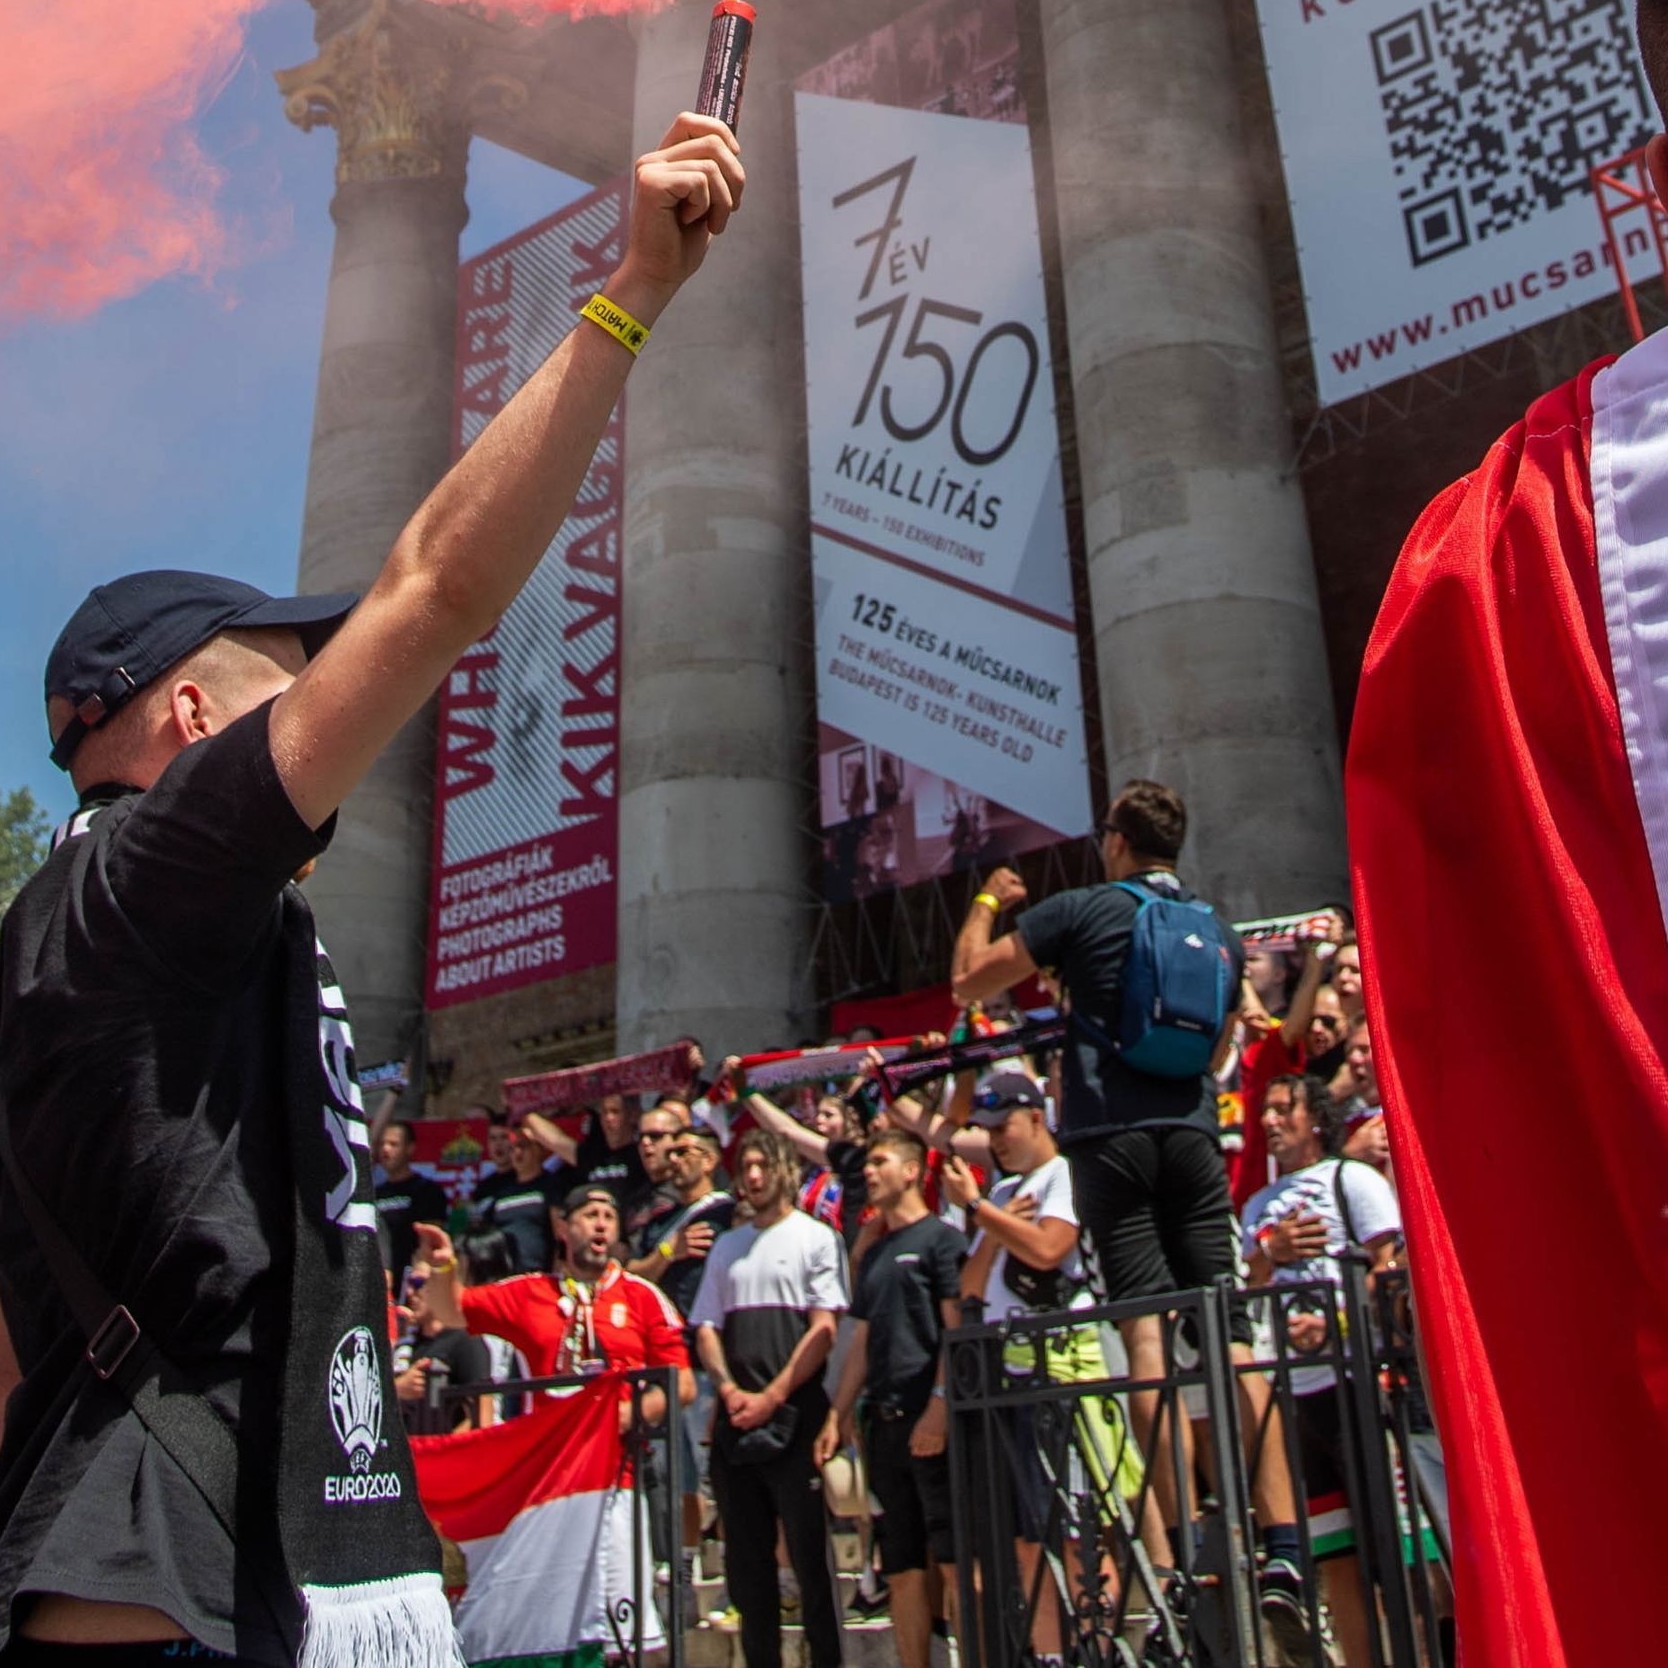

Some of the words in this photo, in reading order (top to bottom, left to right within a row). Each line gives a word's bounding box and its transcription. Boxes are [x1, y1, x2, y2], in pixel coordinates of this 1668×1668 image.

[832, 154, 919, 302] 7
[888, 235, 932, 286] ÉV
[461, 258, 512, 420] ARE
[852, 291, 1039, 467] 150
[835, 496, 871, 526] YEARS
[882, 514, 905, 538] 150
[903, 522, 986, 568] EXHIBITIONS
[836, 443, 1003, 531] KIÁLLÍTÁS
[850, 592, 897, 634] 125
[895, 617, 939, 655] ÉVES
[938, 638, 953, 660] A
[442, 619, 501, 802] WH
[558, 651, 619, 819] KIK
[828, 657, 905, 706] BUDAPEST
[904, 691, 920, 713] IS
[923, 696, 949, 724] 125
[951, 712, 1001, 750] YEARS
[1000, 733, 1035, 765] OLD
[837, 633, 871, 658] THE
[966, 689, 1068, 750] KUNSTHALLE
[439, 844, 554, 903] FOTOGRÁFIÁK
[434, 955, 493, 993] ABOUT
[492, 933, 567, 978] ARTISTS
[436, 902, 565, 963] PHOTOGRAPHS
[325, 1471, 402, 1502] EURO2020
